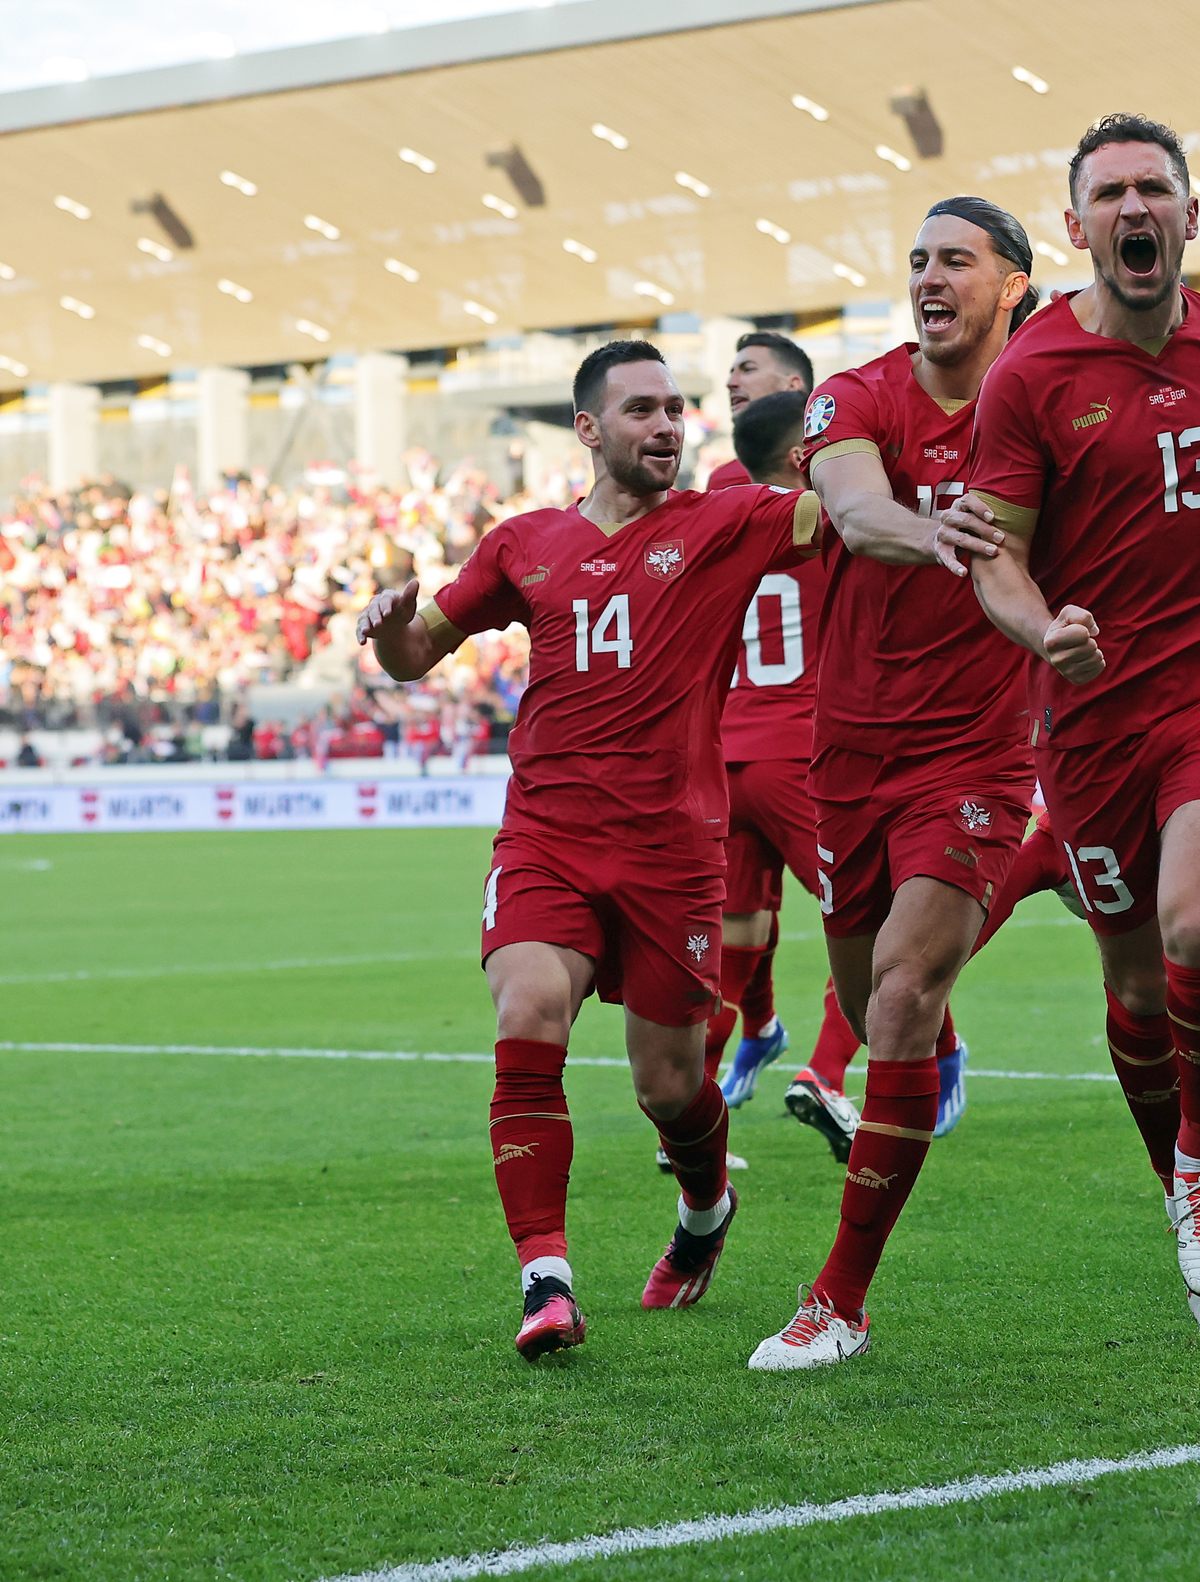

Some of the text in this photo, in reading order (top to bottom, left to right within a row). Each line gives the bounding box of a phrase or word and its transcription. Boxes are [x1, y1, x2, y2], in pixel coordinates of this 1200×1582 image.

[1148, 392, 1165, 406] SRB
[1169, 388, 1187, 401] BGR
[1071, 409, 1109, 431] PUMA
[923, 448, 938, 459] SRB
[943, 450, 959, 460] BGR
[580, 562, 596, 572] SRB
[601, 563, 616, 572] BGR
[572, 593, 633, 672] 14
[729, 573, 804, 689] 0
[1063, 840, 1135, 915] 13
[493, 1149, 524, 1167] UMA
